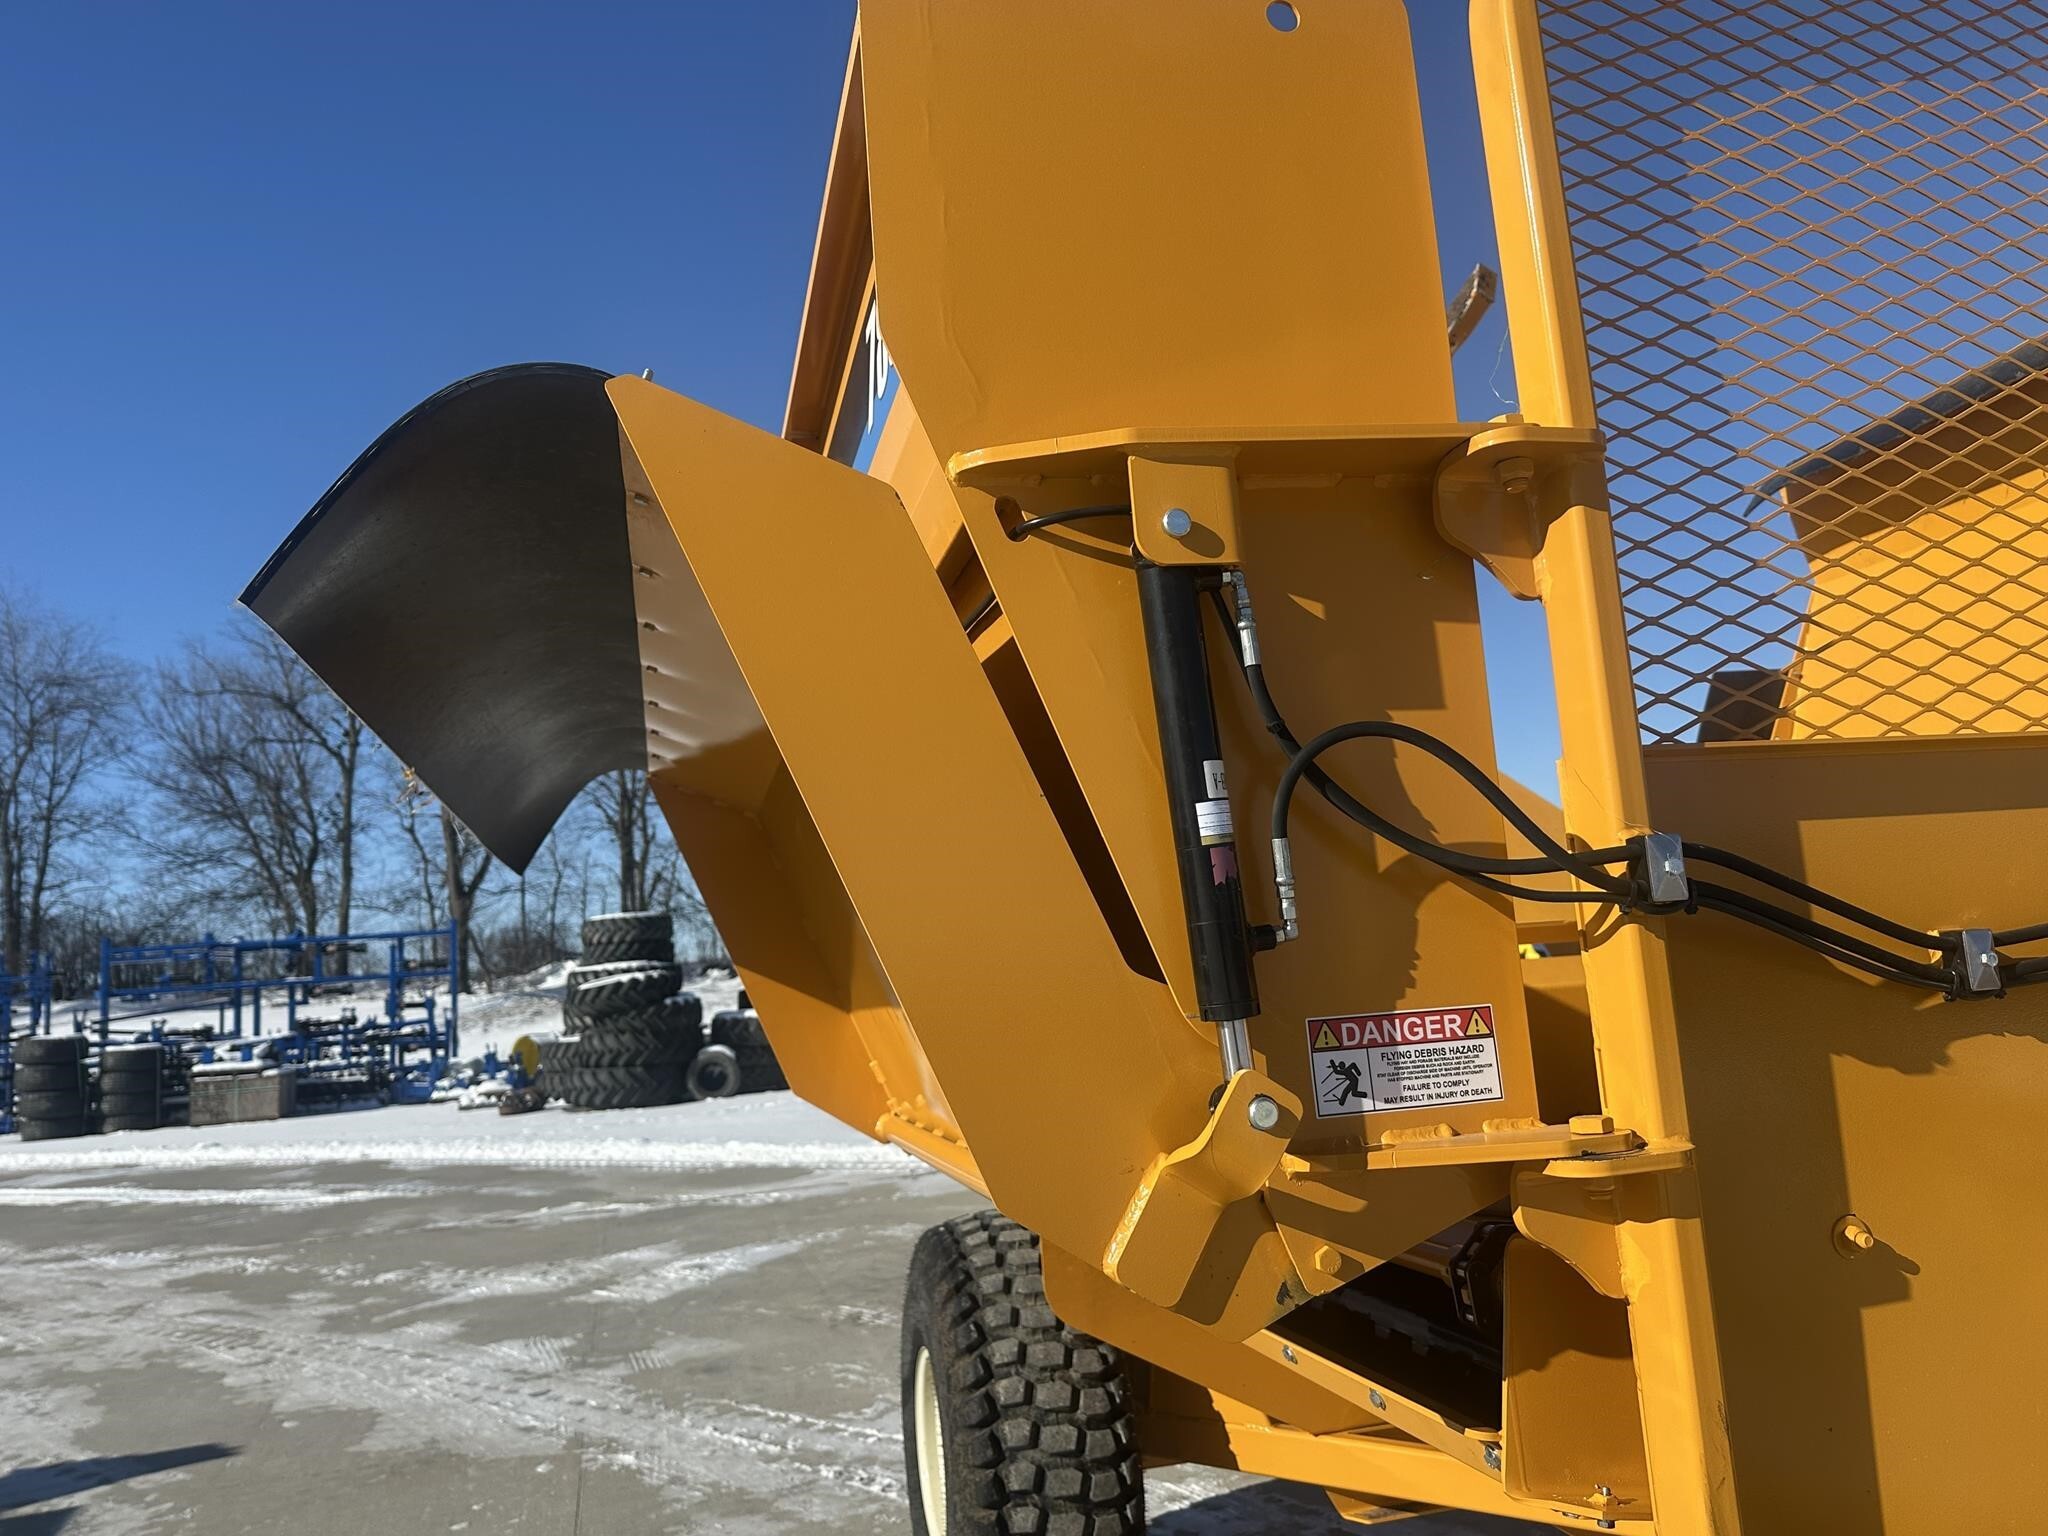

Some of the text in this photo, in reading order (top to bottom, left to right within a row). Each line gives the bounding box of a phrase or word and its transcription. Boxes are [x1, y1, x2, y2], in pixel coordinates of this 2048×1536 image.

[866, 300, 894, 435] To
[1340, 1014, 1464, 1046] DANGER
[1381, 1044, 1484, 1061] FLYING DEBRIS HAZARD
[1403, 1083, 1431, 1091] FAILURE
[1443, 1079, 1469, 1087] COMPLY
[1384, 1096, 1398, 1104] MAY
[1400, 1094, 1425, 1102] RESULT
[1435, 1091, 1458, 1099] INJURY
[1471, 1087, 1492, 1095] DEATH
